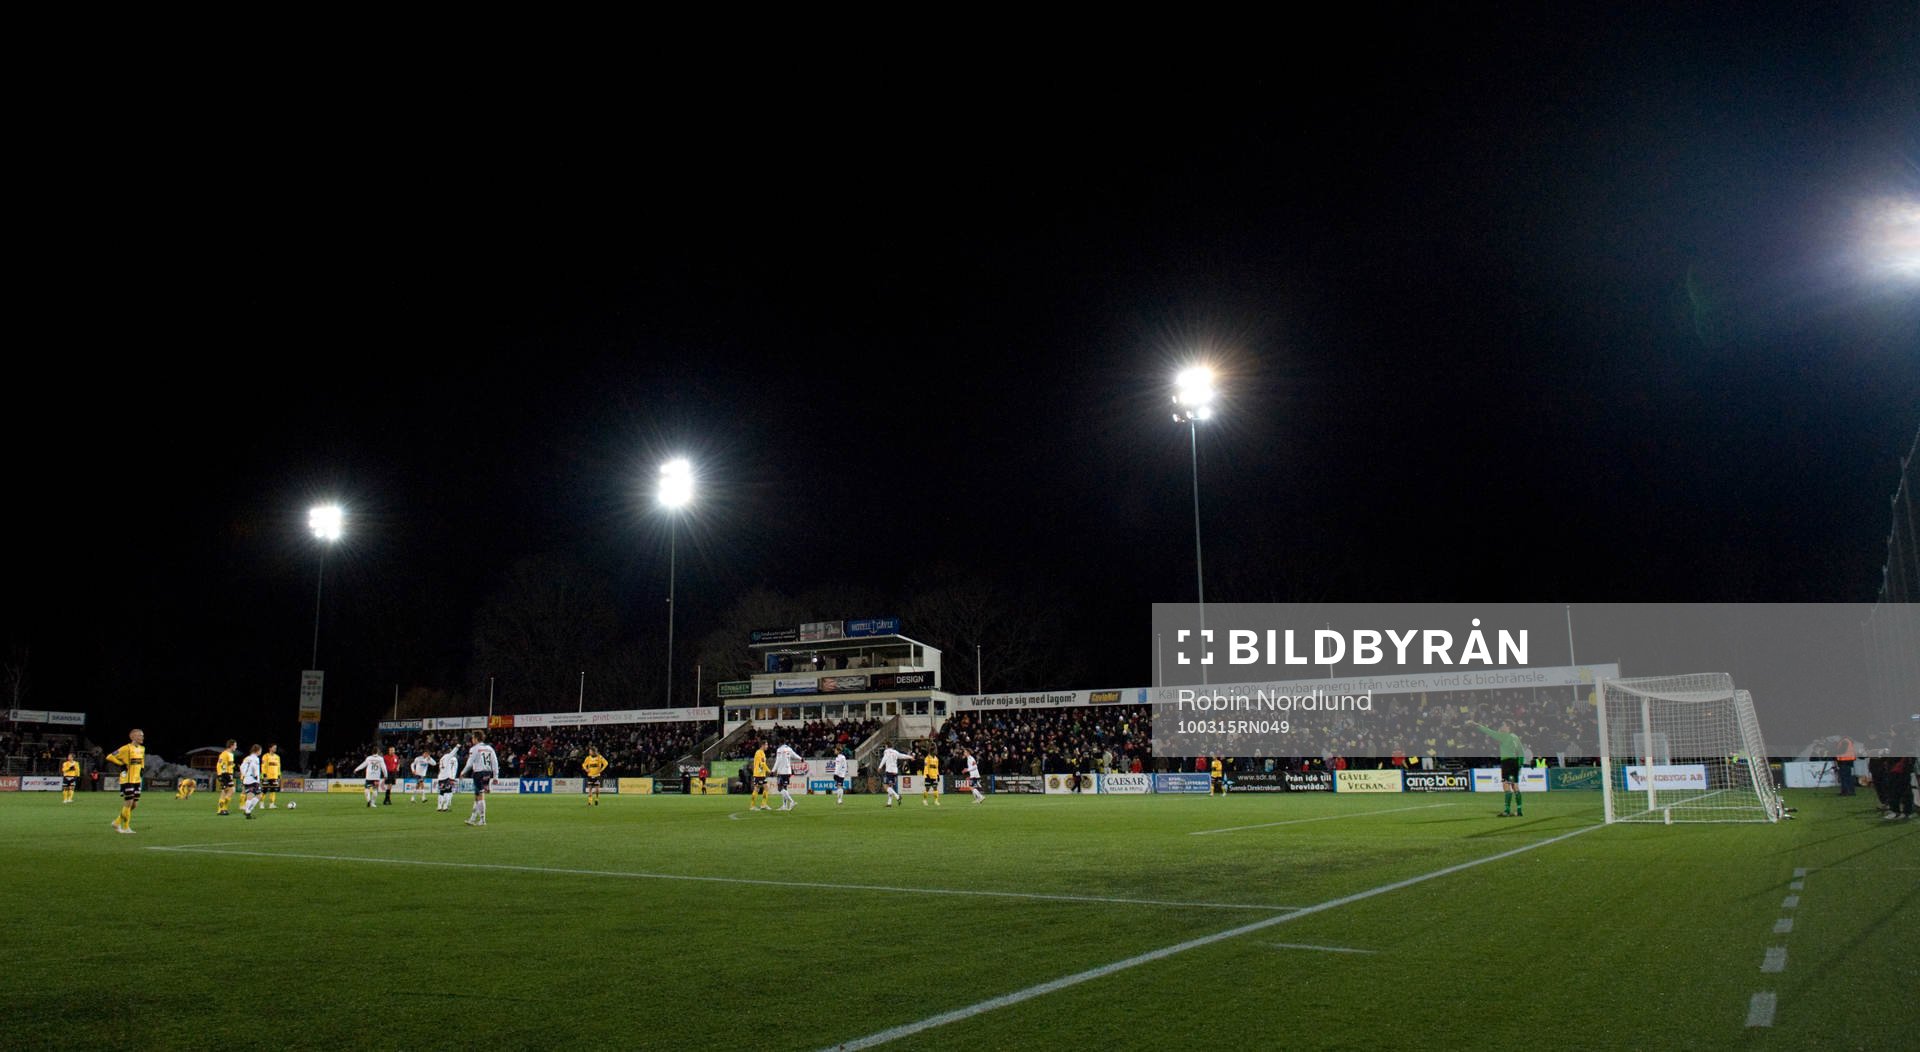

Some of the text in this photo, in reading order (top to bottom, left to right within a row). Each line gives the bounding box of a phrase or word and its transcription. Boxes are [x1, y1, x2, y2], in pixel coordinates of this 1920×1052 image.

[896, 675, 924, 684] DESIGN
[1359, 678, 1382, 691] från
[1386, 677, 1429, 692] vatten,
[1433, 674, 1460, 688] vind
[1462, 675, 1473, 688] &
[1475, 671, 1548, 686] biobränsle.
[971, 692, 1077, 707] Varför nöja sig med lagom?
[1107, 777, 1144, 786] CAESAR
[1286, 775, 1303, 783] Från
[1320, 773, 1332, 781] till
[522, 780, 550, 792] YIT
